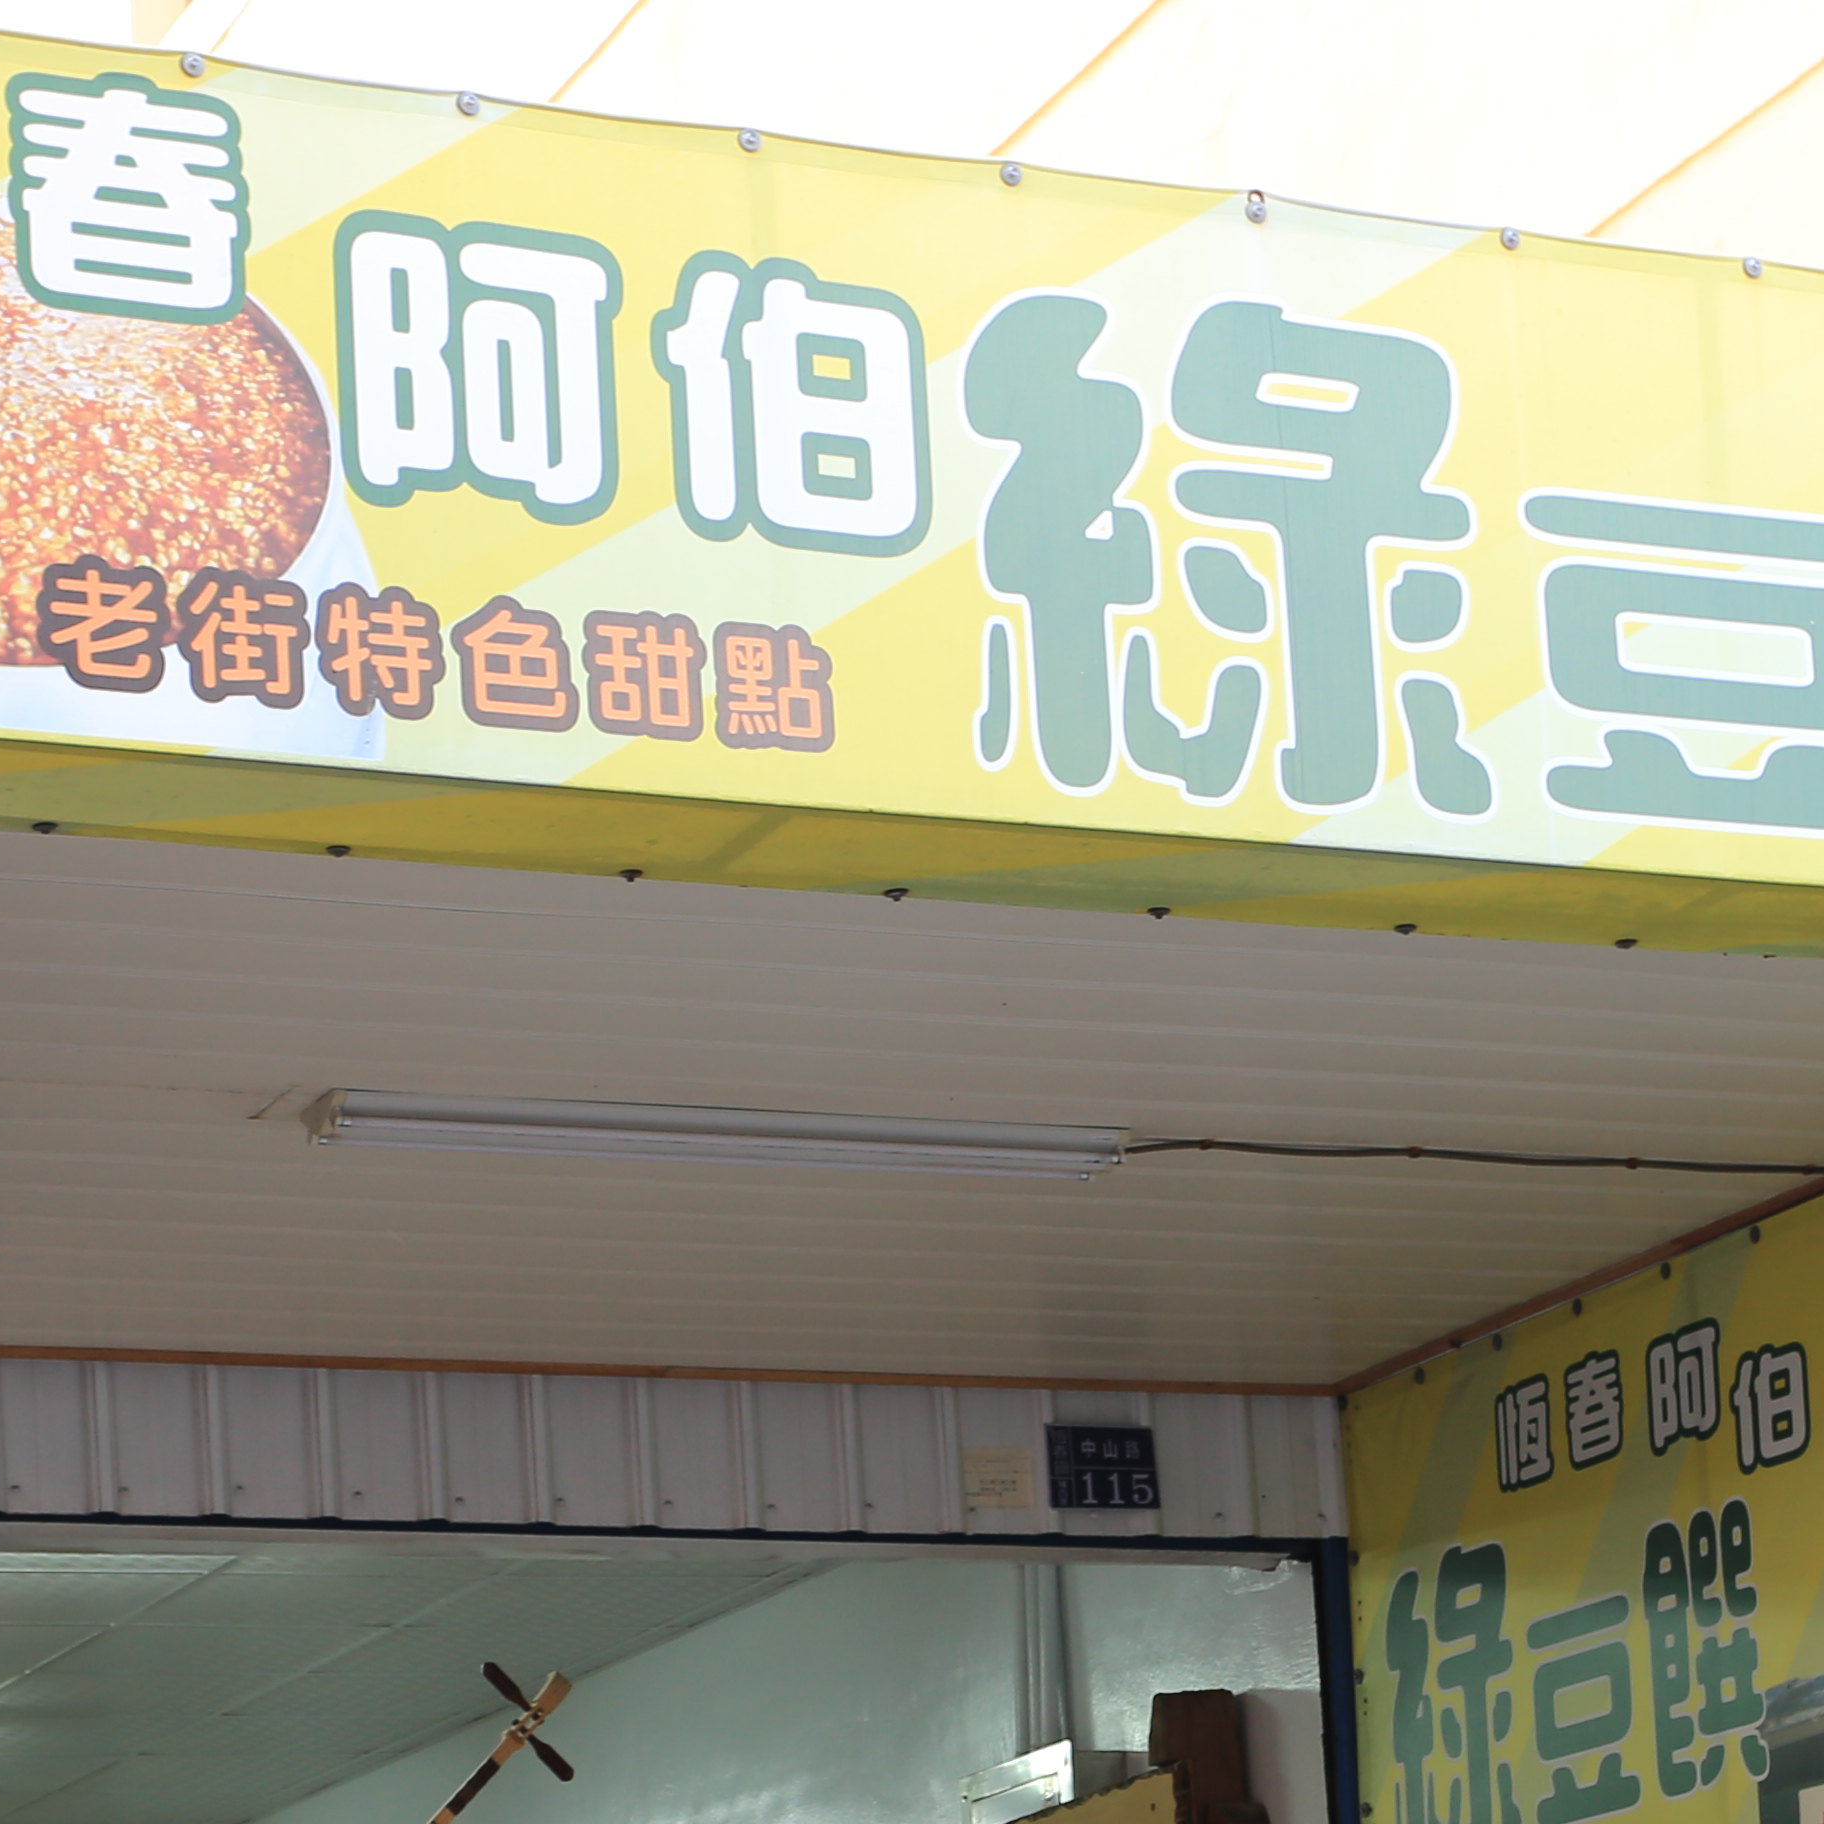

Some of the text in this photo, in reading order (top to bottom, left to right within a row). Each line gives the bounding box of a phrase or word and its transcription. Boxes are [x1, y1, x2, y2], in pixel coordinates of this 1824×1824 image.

[334, 213, 933, 555] 阿伯
[40, 555, 834, 751] 老街特色甜點
[1081, 1471, 1154, 1505] 115
[1496, 1318, 1811, 1493] 恆春 阿伯
